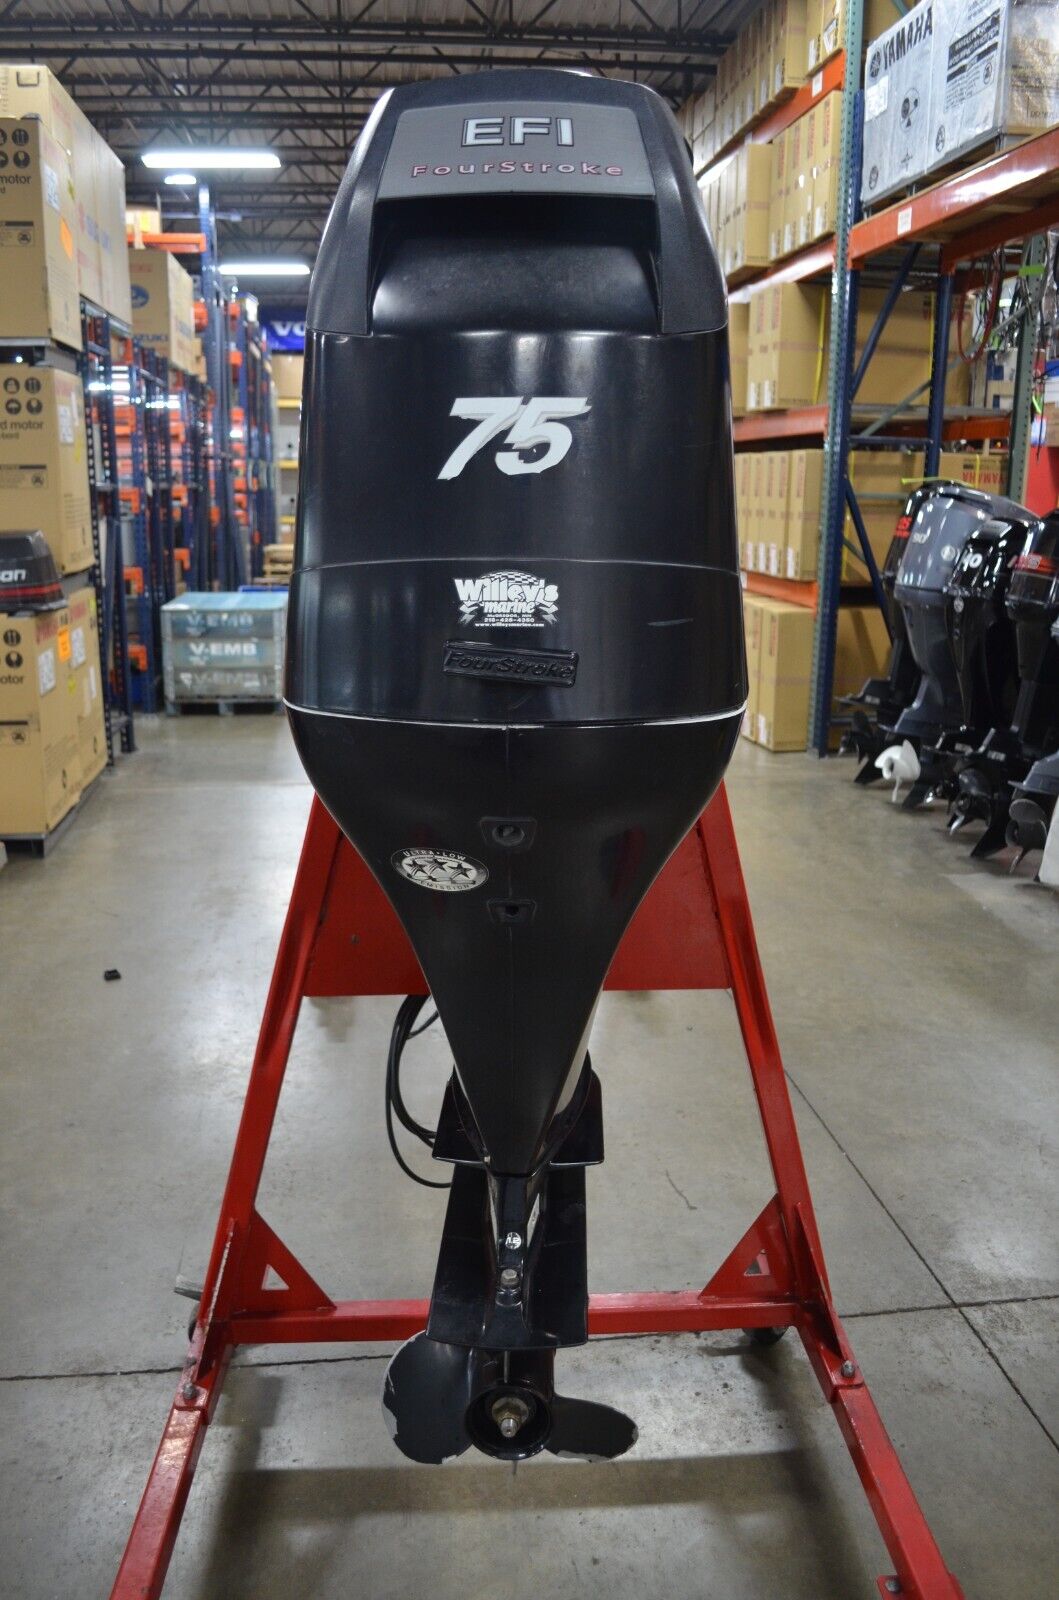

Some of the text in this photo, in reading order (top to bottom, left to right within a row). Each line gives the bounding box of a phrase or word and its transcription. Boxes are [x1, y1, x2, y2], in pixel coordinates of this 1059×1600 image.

[883, 6, 933, 70] YAMAHA
[461, 117, 575, 147] EFI
[411, 160, 623, 178] FourStroke
[10, 420, 44, 430] motor
[436, 396, 592, 480] 75
[483, 600, 535, 613] marine
